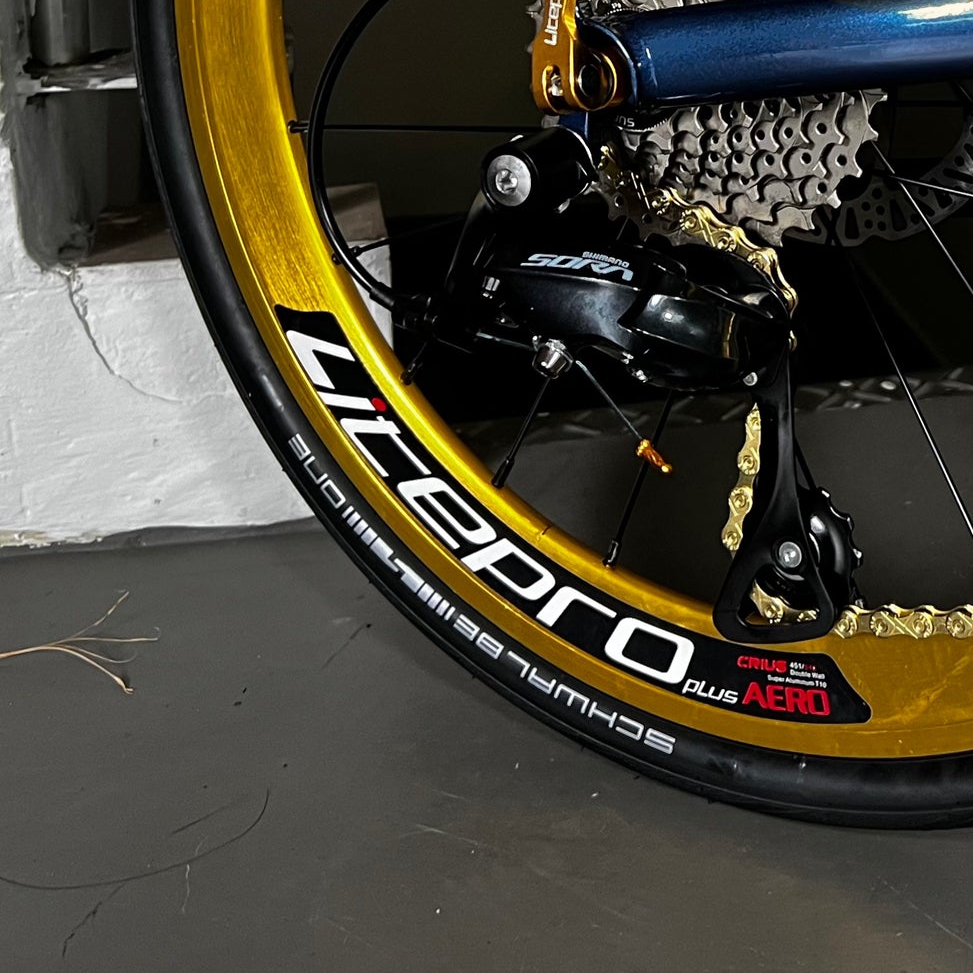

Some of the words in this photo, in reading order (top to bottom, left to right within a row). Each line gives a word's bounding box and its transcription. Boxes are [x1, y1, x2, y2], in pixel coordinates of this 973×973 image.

[519, 253, 634, 282] SORA
[581, 250, 630, 269] SHIMANO
[287, 432, 347, 510] ONE
[736, 655, 787, 674] CRIUS
[450, 611, 676, 756] SCHWALBE
[742, 681, 832, 717] AERO
